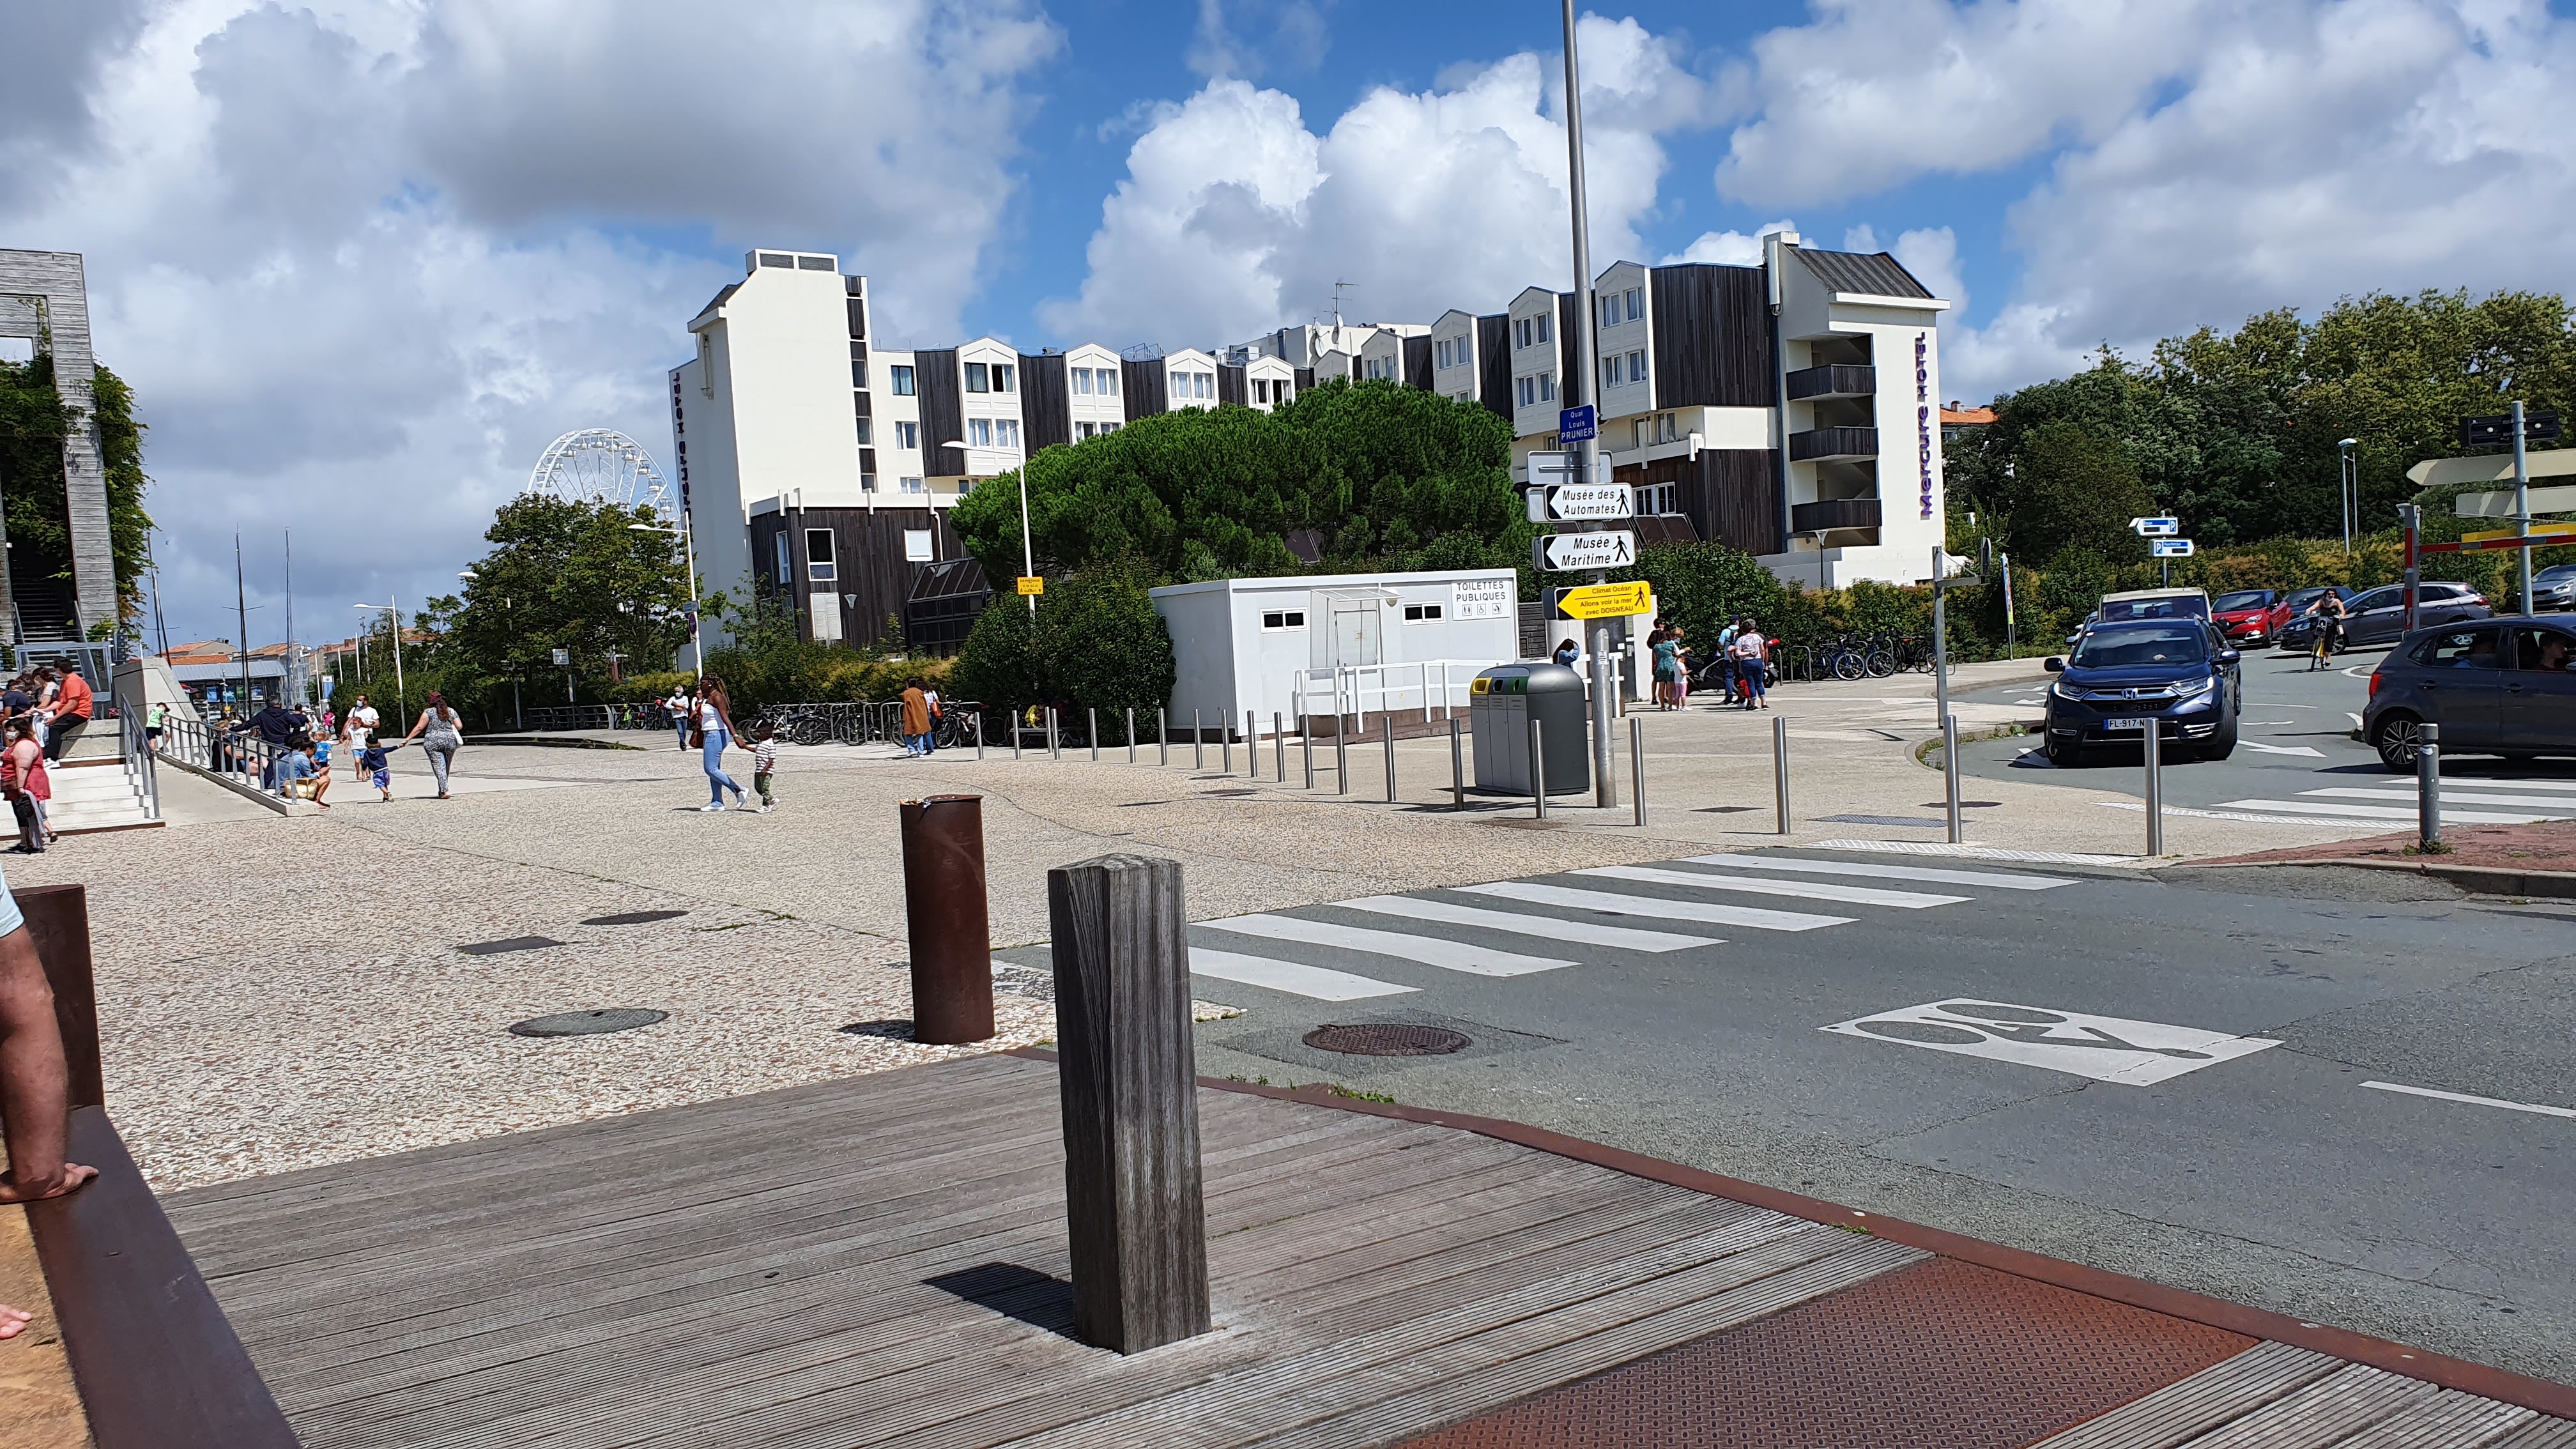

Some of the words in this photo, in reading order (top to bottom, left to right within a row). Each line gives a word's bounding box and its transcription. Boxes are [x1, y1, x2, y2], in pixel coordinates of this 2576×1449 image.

[1915, 332, 1928, 397] HOTEL
[673, 372, 685, 434] HOTEL
[1570, 410, 1583, 418] Quai
[1568, 420, 1585, 429] Louis
[1561, 427, 1593, 441] PRUNIER
[1917, 405, 1933, 516] Mercure
[678, 441, 694, 542] ercure
[1562, 489, 1593, 501] Musée
[1597, 489, 1614, 500] des
[1563, 504, 1616, 515] Automates
[1573, 537, 1610, 549] Musée
[1561, 553, 1611, 567] Maritime
[1457, 581, 1504, 591] TOILETTES
[1456, 592, 1505, 602] PUBLIQUES
[1600, 606, 1634, 614] DOISNEAU
[2110, 719, 2145, 728] FL-917-N
